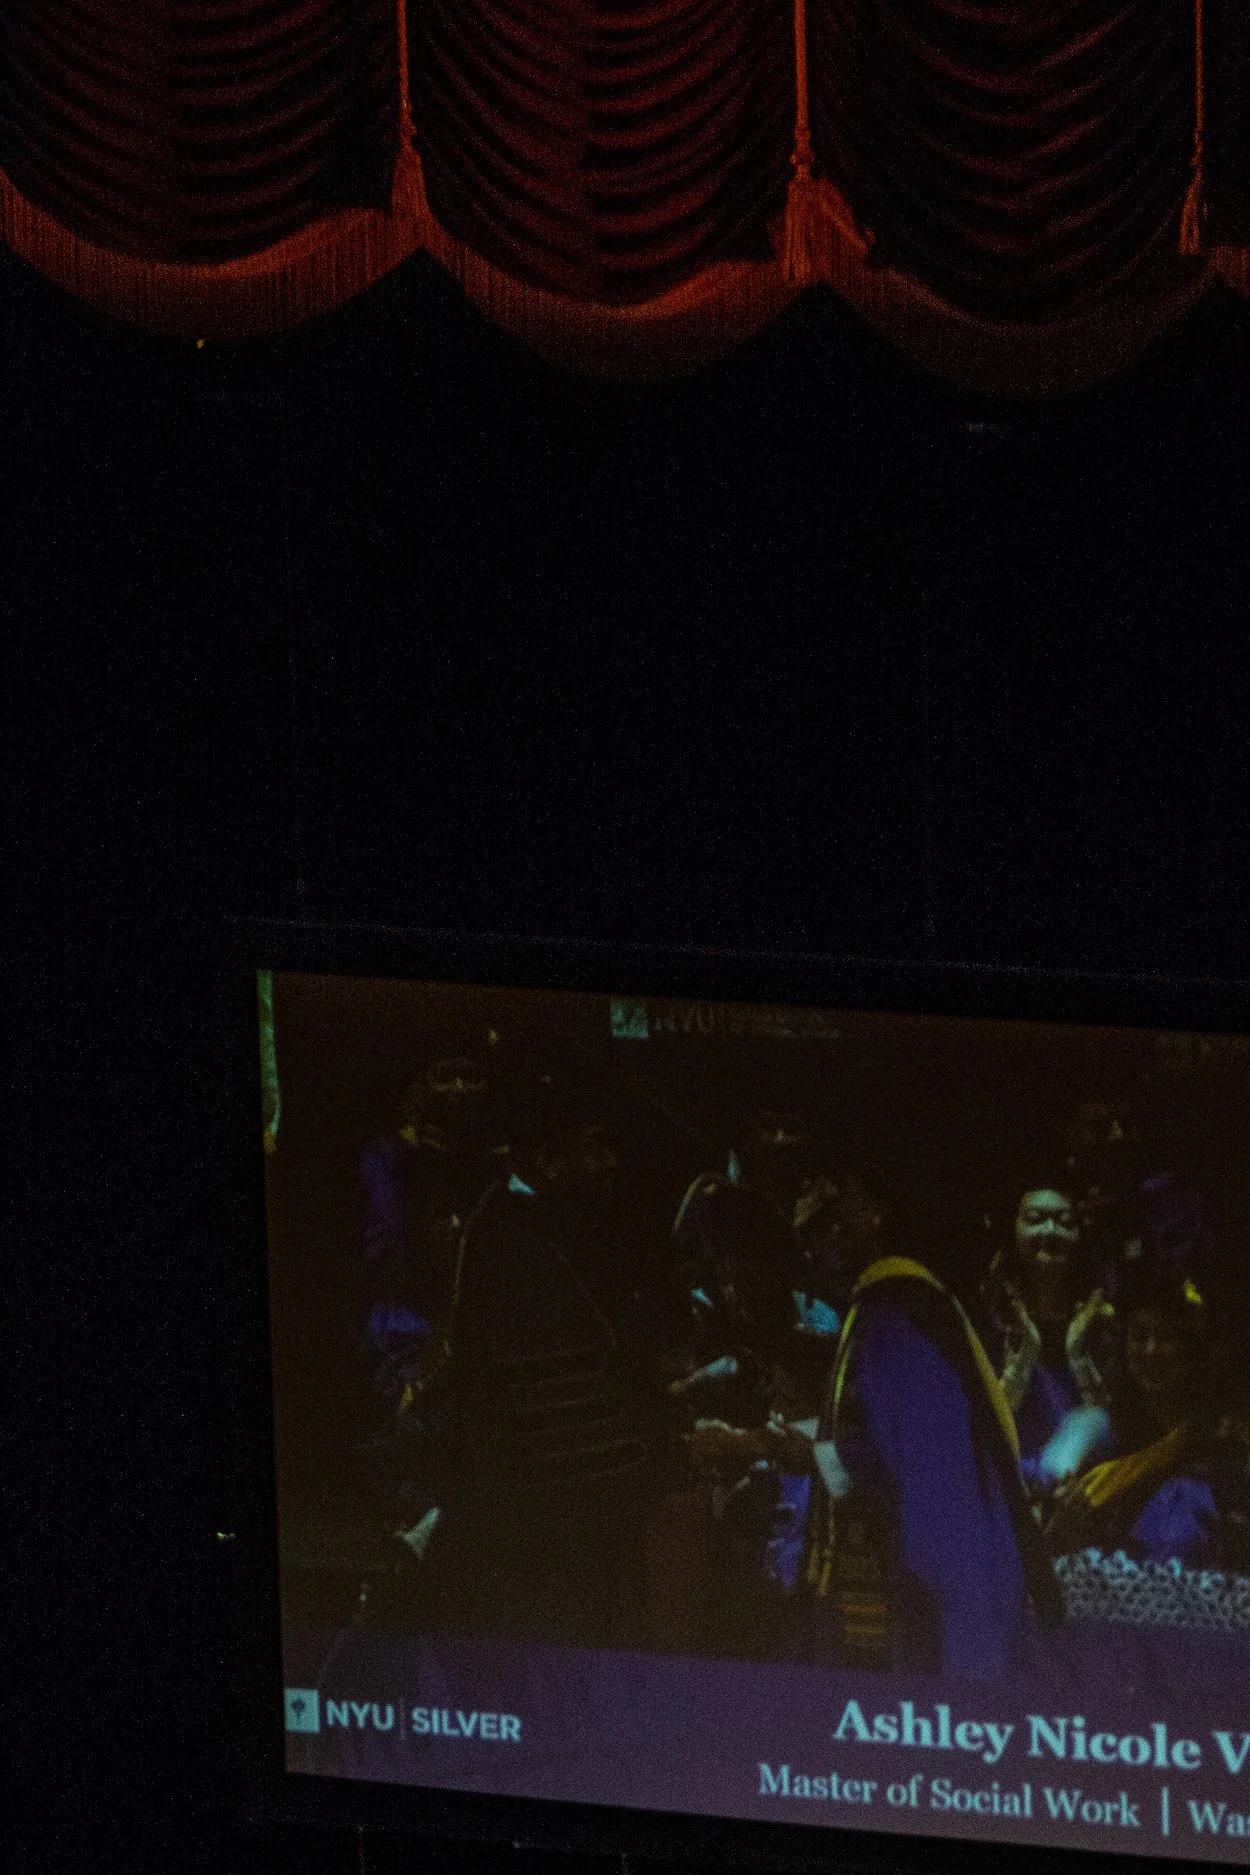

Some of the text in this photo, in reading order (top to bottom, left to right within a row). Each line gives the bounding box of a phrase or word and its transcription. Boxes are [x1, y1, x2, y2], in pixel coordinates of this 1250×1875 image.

[326, 1700, 521, 1742] NYU SILVER
[832, 1699, 1014, 1763] Ashley
[1025, 1713, 1202, 1769] Nicole
[757, 1763, 878, 1805] Master
[887, 1774, 923, 1807] of
[930, 1778, 1033, 1818] Social
[1043, 1785, 1141, 1827] Work
